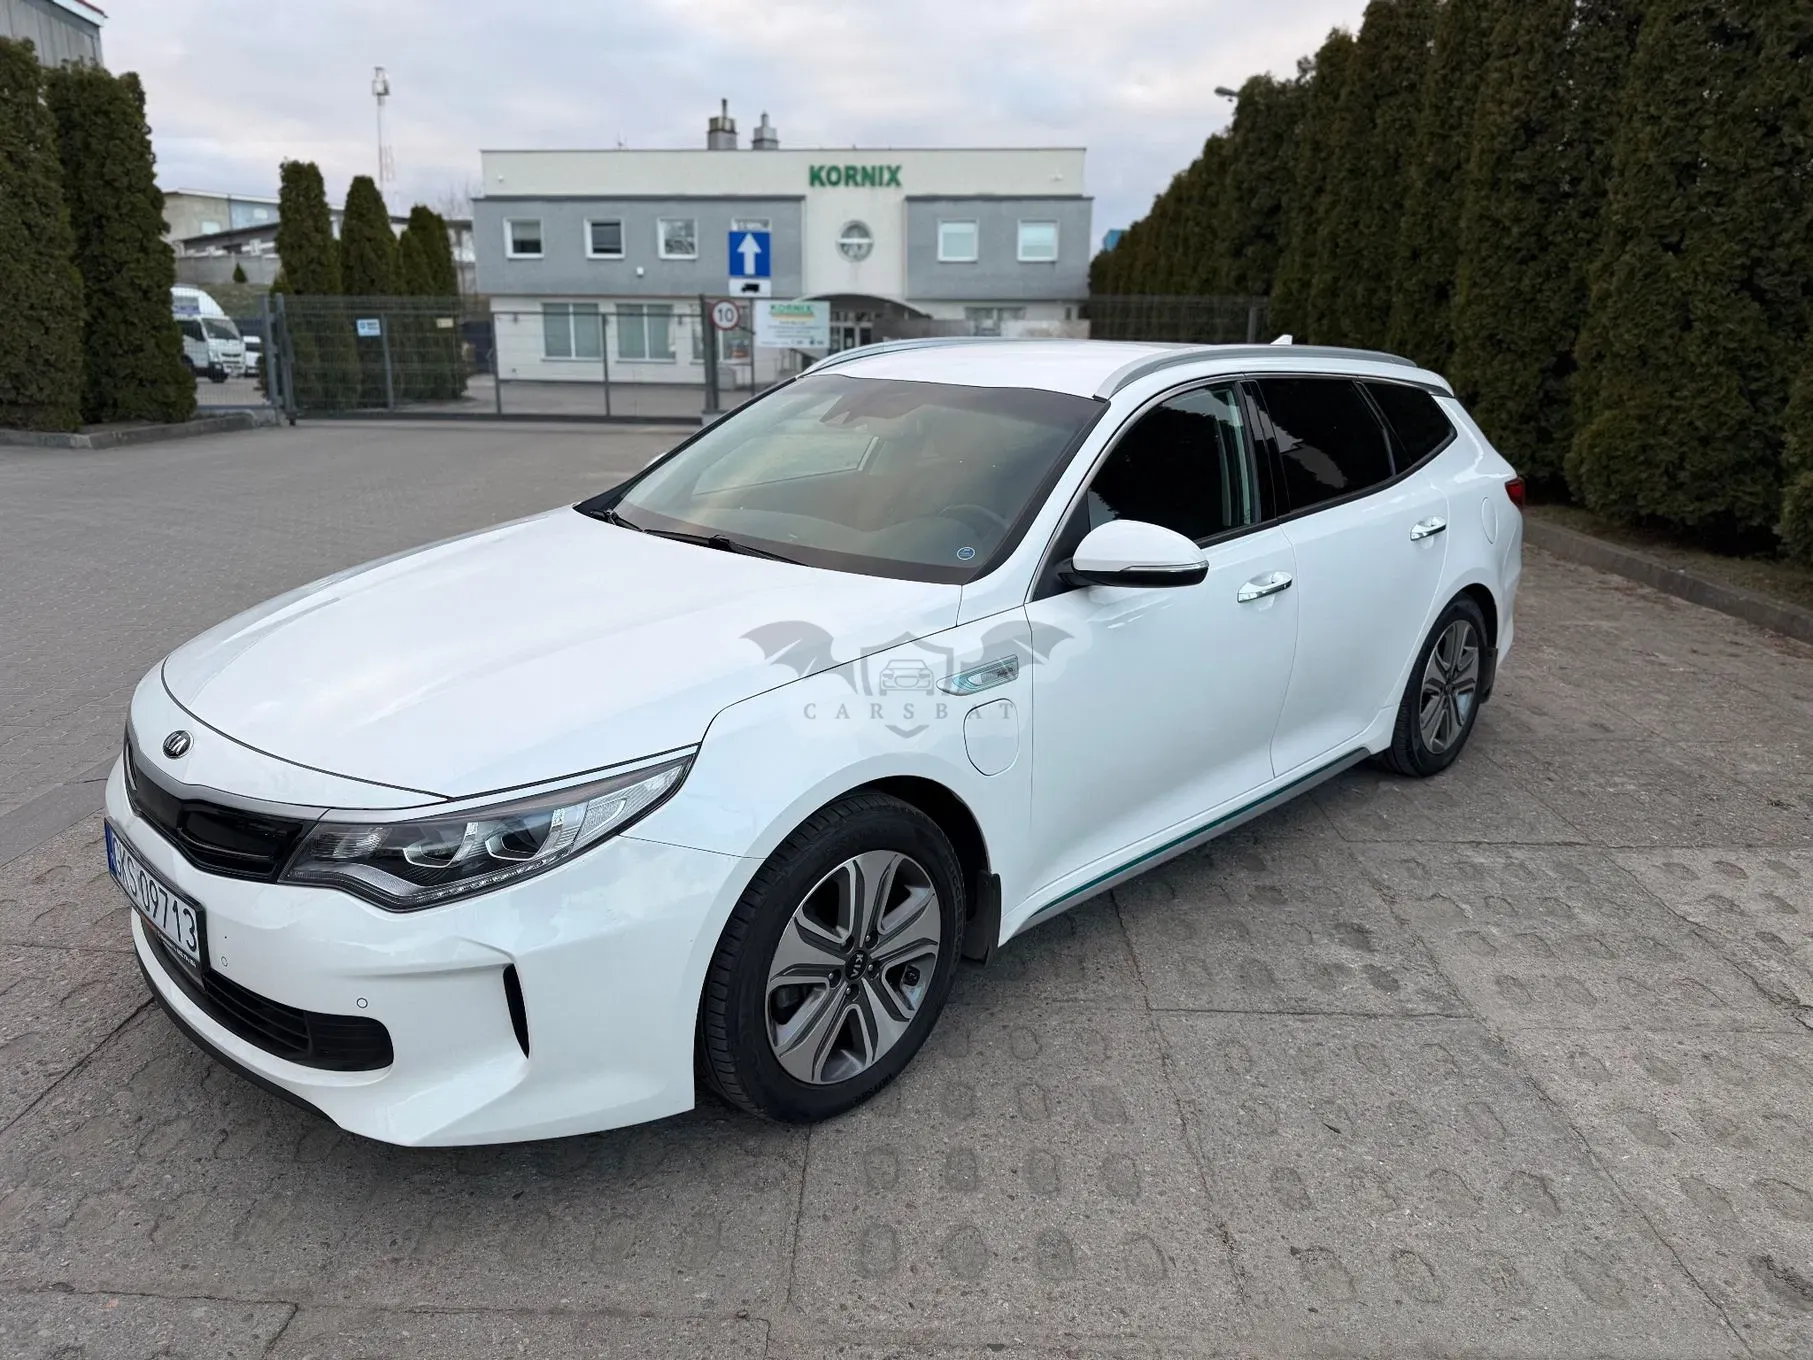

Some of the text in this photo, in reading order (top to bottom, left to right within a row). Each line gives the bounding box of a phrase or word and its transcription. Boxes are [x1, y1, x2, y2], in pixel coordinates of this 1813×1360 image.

[808, 164, 902, 188] KORNIX
[717, 307, 734, 323] 10
[138, 869, 198, 953] 09713
[849, 953, 864, 978] KIA
